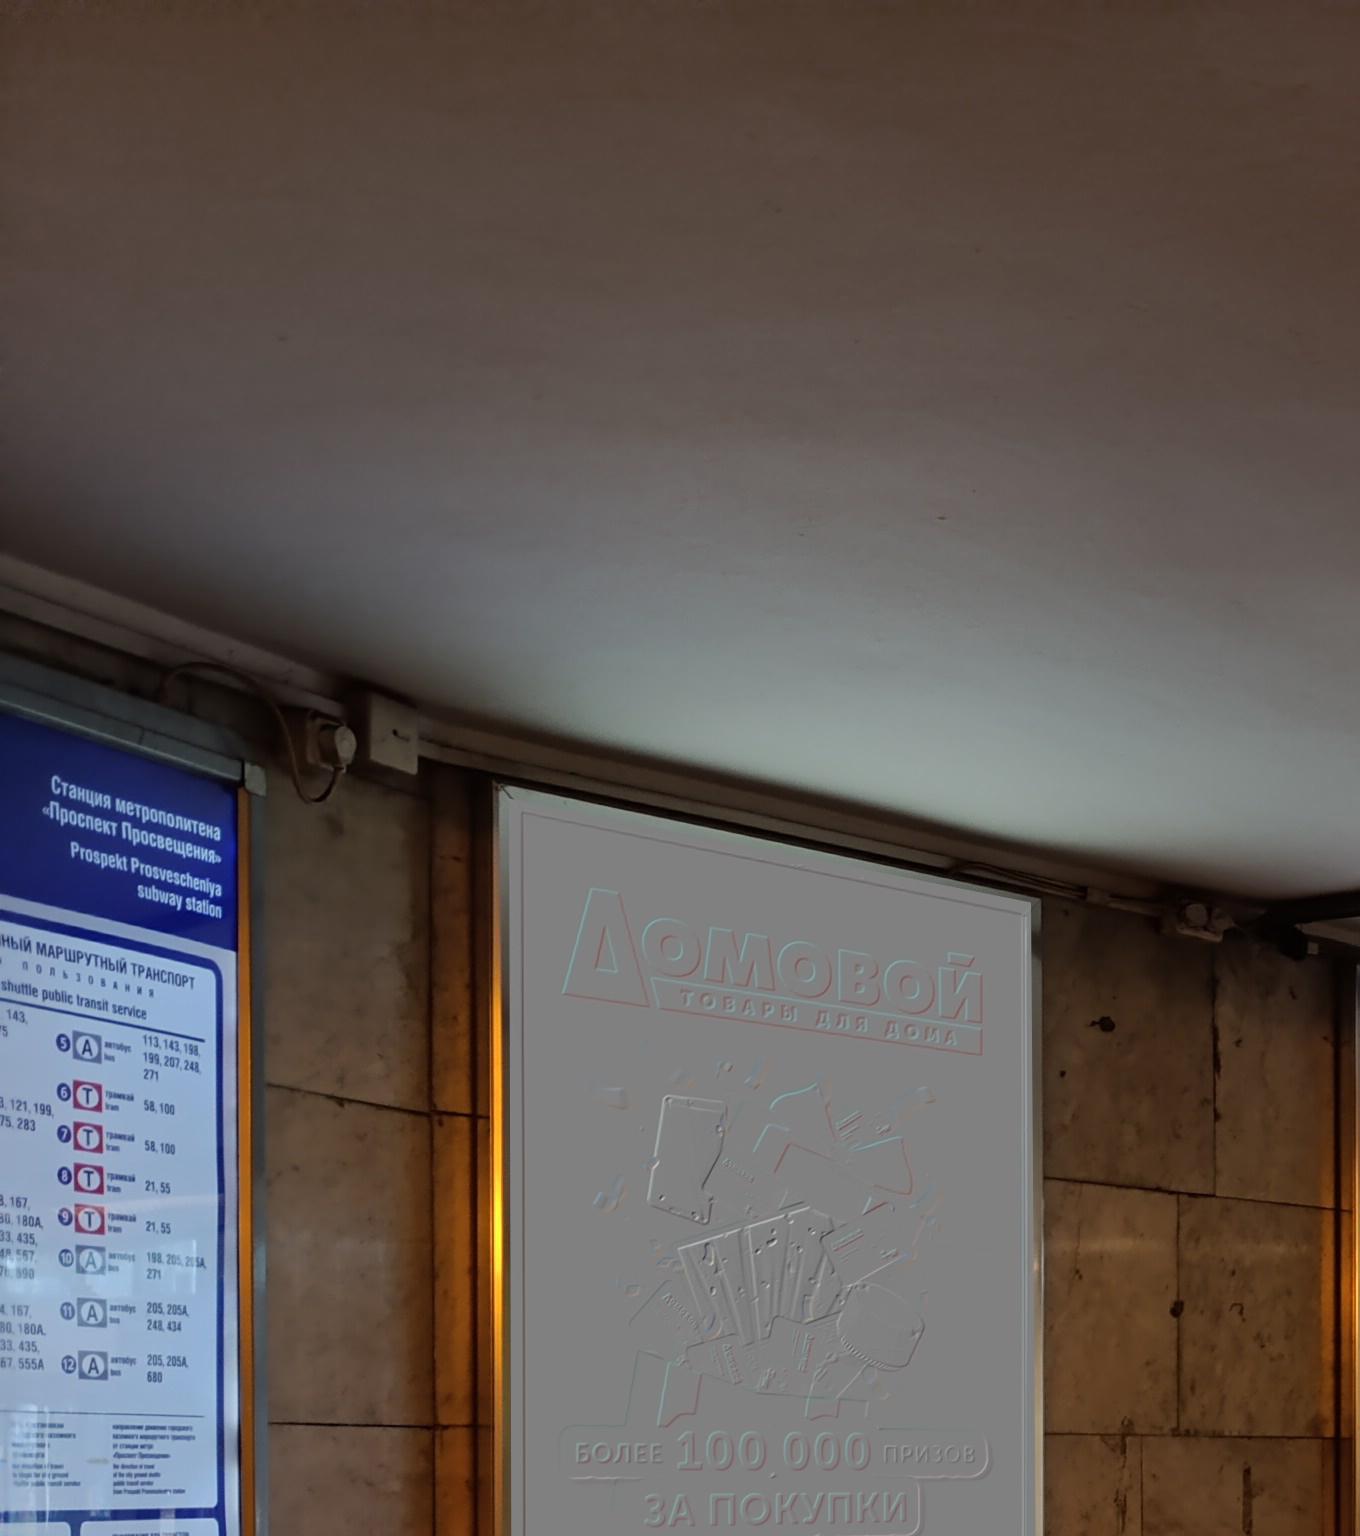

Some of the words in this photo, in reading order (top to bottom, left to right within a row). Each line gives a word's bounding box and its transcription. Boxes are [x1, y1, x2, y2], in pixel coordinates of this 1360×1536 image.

[51, 775, 111, 810] Станция
[115, 798, 221, 841] метрополитена
[42, 801, 118, 836] «Проспект
[122, 821, 221, 864] Просвещения»
[70, 842, 128, 872] Prospekt
[131, 858, 222, 897] Prosvescheniya
[137, 884, 182, 911] subway
[185, 896, 222, 919] station
[36, 941, 127, 975] МАРШРУТНЫЙ
[131, 961, 195, 990] ТРАНСПОРТ
[42, 988, 73, 1007] public
[76, 993, 109, 1015] transit
[111, 1002, 147, 1020] service
[680, 988, 798, 1022] ТОВАРЫ
[815, 1010, 870, 1035] ДЛЯ
[884, 1019, 958, 1048] ДОМА
[143, 1069, 159, 1082] 271
[160, 1103, 175, 1115] 100
[17, 1117, 36, 1132] 283
[160, 1142, 176, 1155] 100
[160, 1182, 171, 1194] 55
[161, 1222, 171, 1235] 55
[146, 1268, 162, 1281] 271
[167, 1320, 182, 1333] 434
[147, 1371, 163, 1383] 680
[575, 1441, 663, 1465] БОЛЕЕ
[676, 1429, 767, 1471] 100
[783, 1430, 872, 1471] 000
[882, 1443, 976, 1465] ПРИЗОВ
[643, 1494, 695, 1528] ЗА
[708, 1490, 908, 1527] ПОКУПКИ
